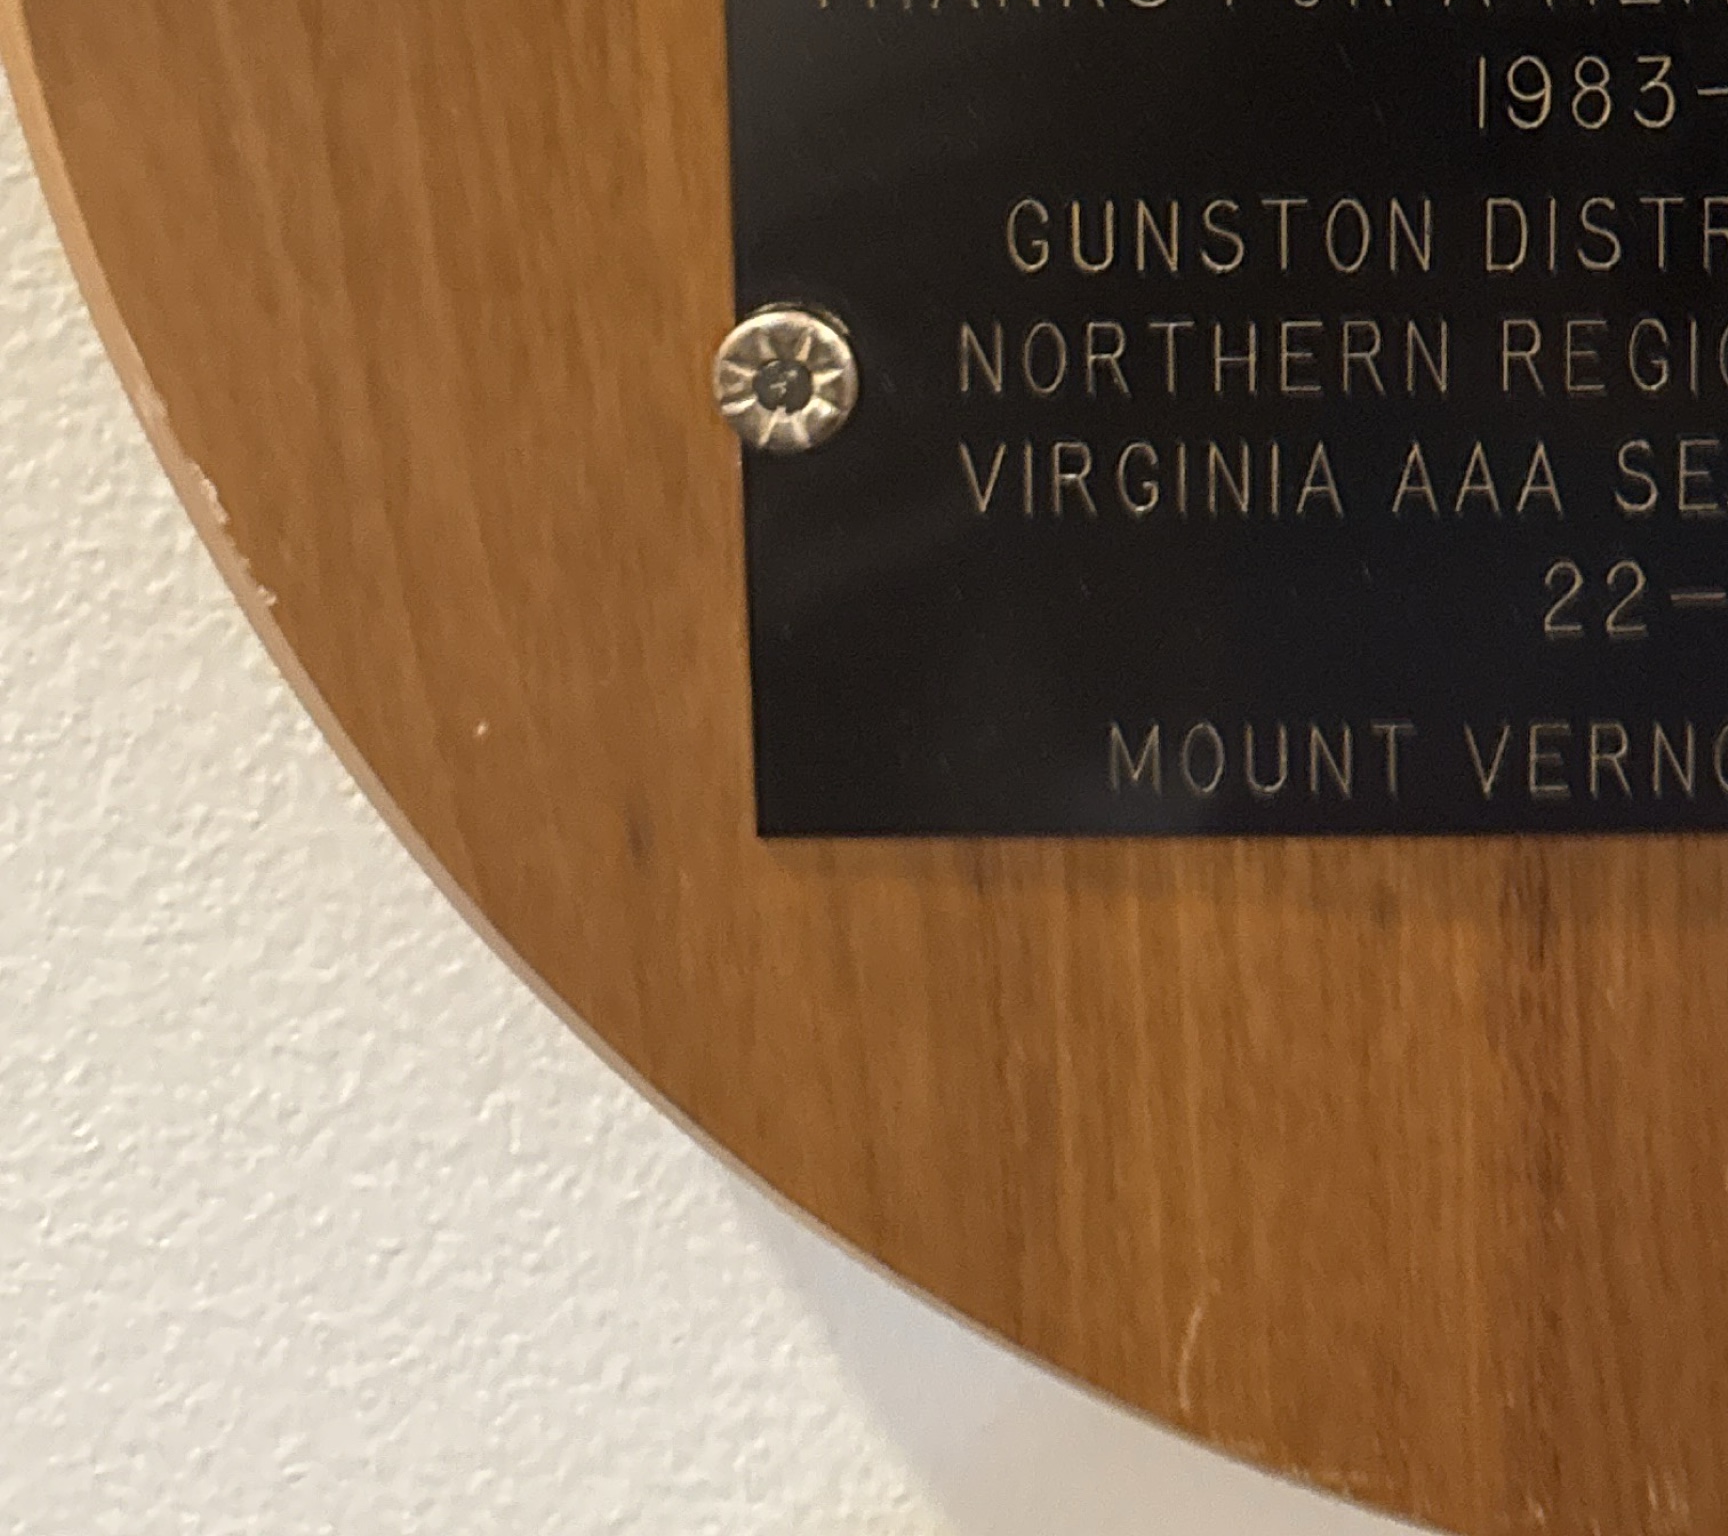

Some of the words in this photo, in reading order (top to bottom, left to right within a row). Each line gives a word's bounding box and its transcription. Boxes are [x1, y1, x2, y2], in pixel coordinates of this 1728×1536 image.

[1006, 196, 1433, 274] GUNSTON
[958, 320, 1450, 396] NORTHERN
[959, 441, 1345, 517] VIRGINIA
[1391, 441, 1565, 516] AAA
[1108, 720, 1415, 797] MOUNT
